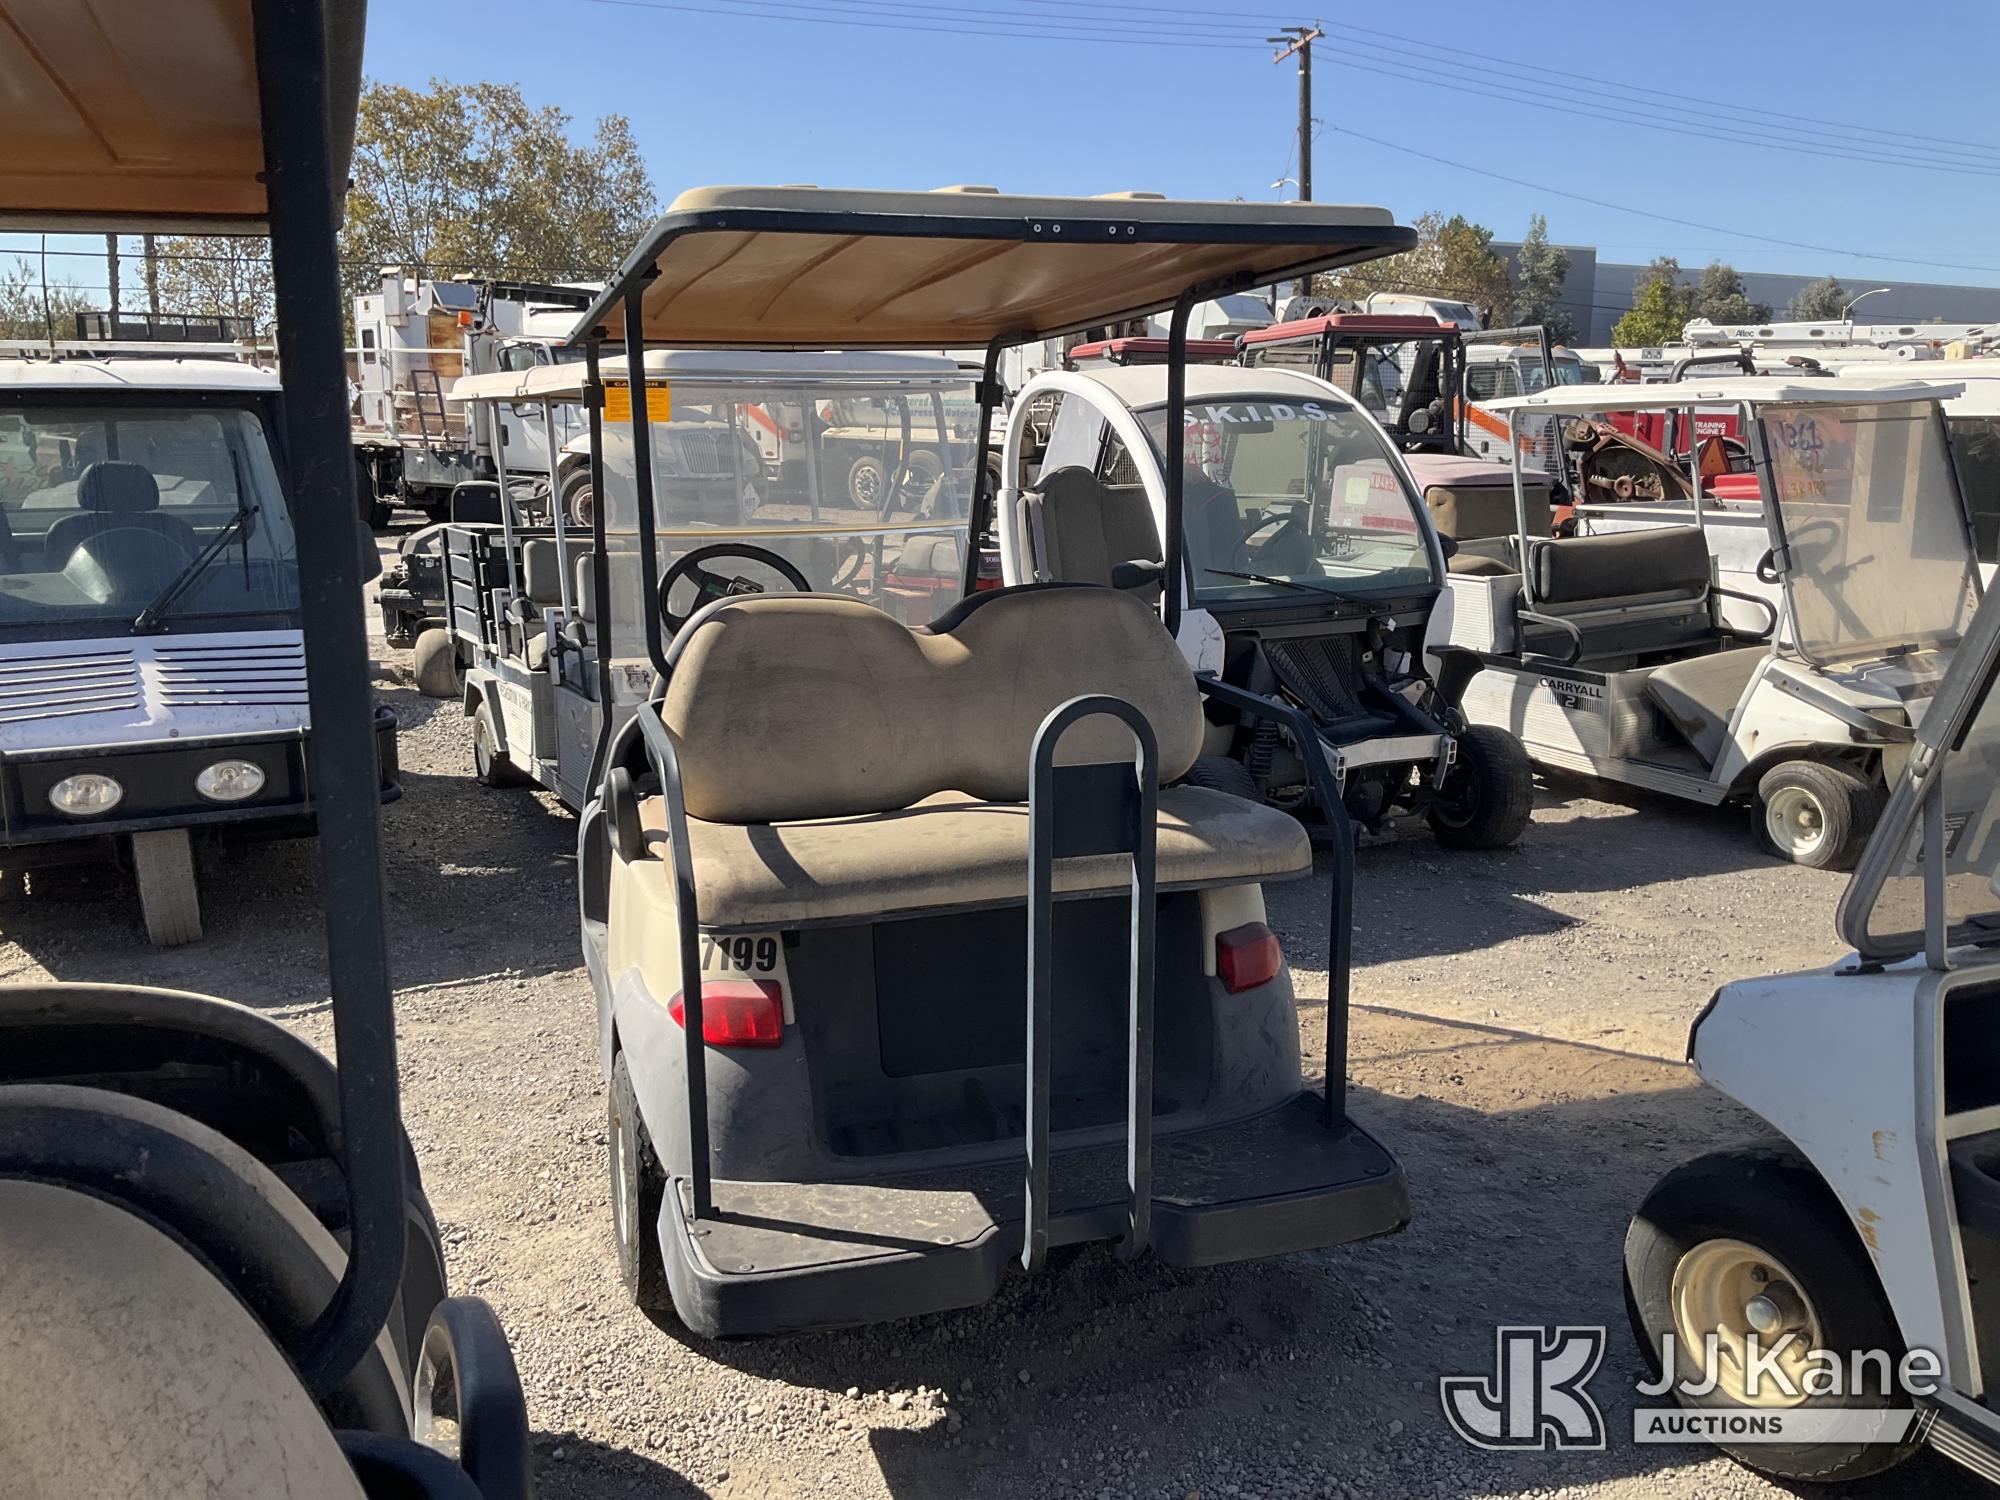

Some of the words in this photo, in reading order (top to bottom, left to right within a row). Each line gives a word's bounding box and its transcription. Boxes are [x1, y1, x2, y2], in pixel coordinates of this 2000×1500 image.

[1736, 329, 1754, 338] Altec
[1695, 421, 1726, 429] TRAINING
[1720, 428, 1726, 436] 2
[1540, 677, 1603, 698] CARRYALL
[1565, 695, 1576, 707] 2
[701, 936, 778, 972] 7199
